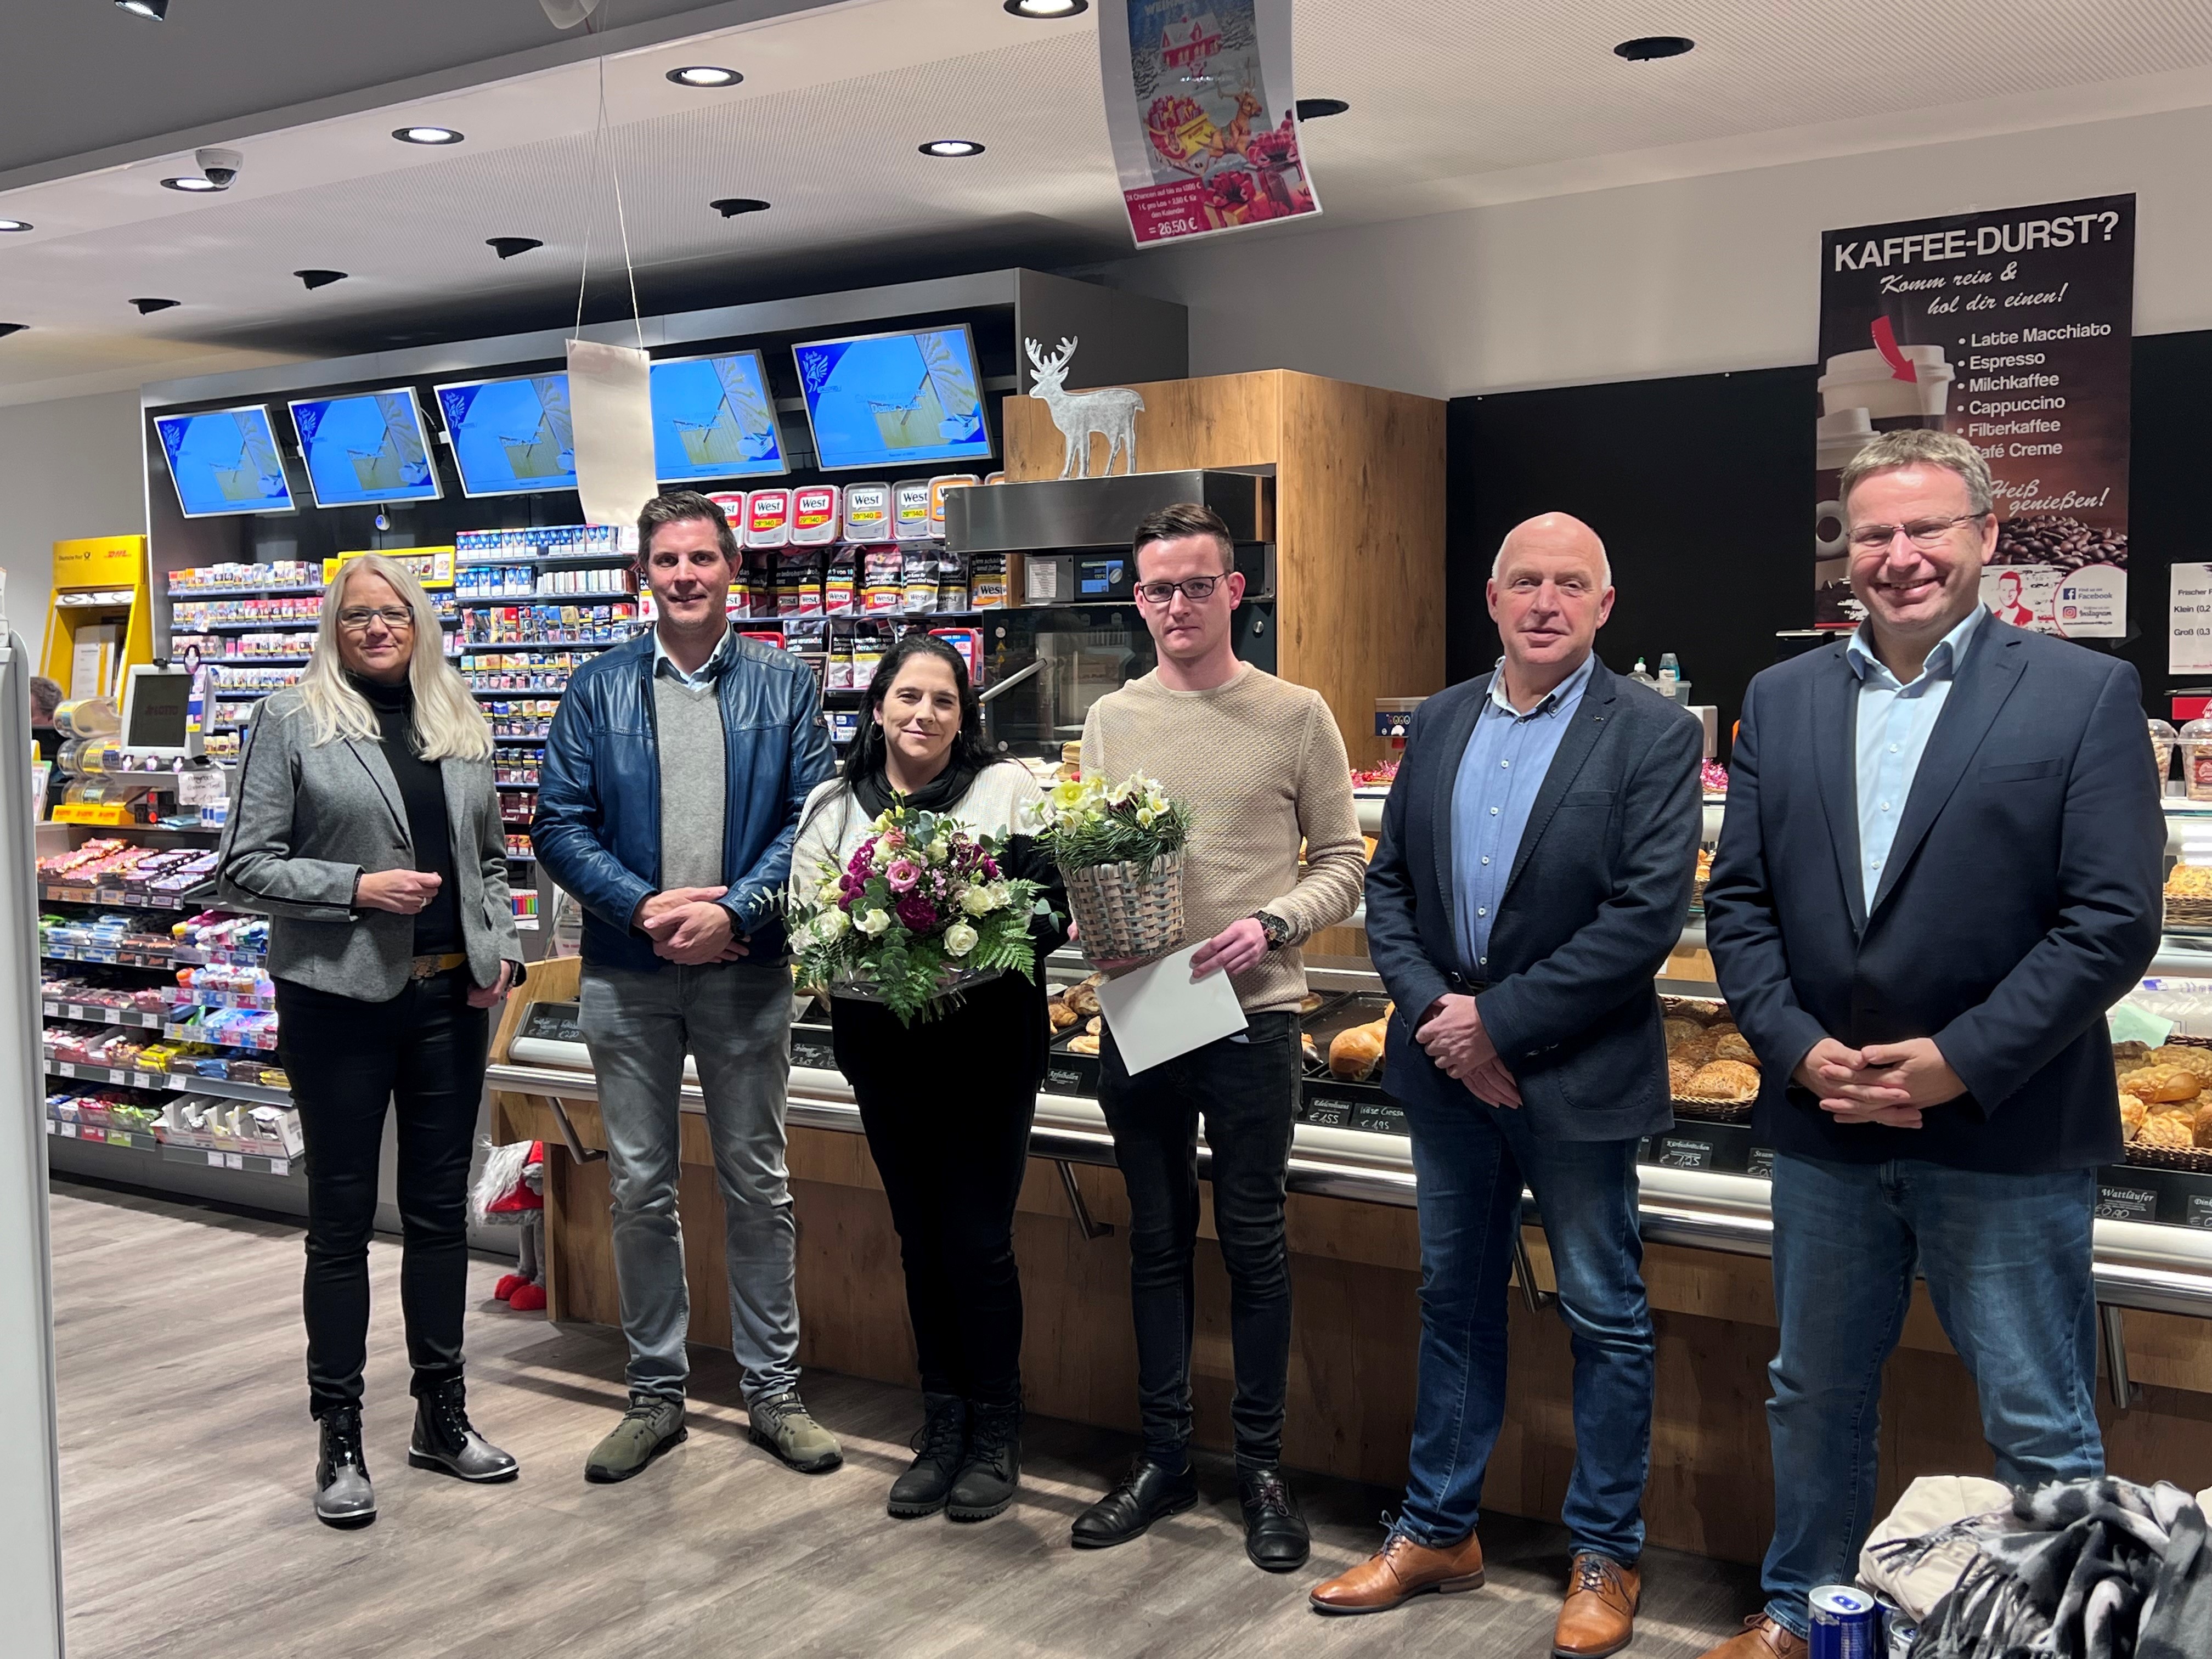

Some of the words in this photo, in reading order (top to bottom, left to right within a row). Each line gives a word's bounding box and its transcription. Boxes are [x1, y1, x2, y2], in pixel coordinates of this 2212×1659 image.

[1158, 219, 1186, 235] 26,50
[1188, 217, 1198, 230] €
[1835, 211, 2119, 272] KAFFEE-DURST?
[1880, 275, 1946, 294] Komm
[1953, 273, 1992, 286] rein
[2001, 261, 2017, 281] &
[1927, 296, 1959, 315] hol
[1966, 294, 1996, 312] dir
[2005, 283, 2069, 308] einen!
[1971, 331, 2018, 347] Latte
[2023, 323, 2111, 343] Macchiato
[1970, 353, 2045, 373] Espresso
[1970, 374, 2059, 392] Milchkaffee
[1969, 397, 2066, 417] Cappuccino
[1969, 420, 2060, 437] Filterkaffee
[2009, 443, 2063, 458] Creme
[904, 493, 927, 502] West
[1991, 479, 2040, 499] Heiß
[758, 502, 781, 511] West
[803, 499, 826, 508] West
[855, 495, 879, 505] West
[2009, 487, 2110, 517] genießen!
[724, 505, 735, 513] est
[108, 550, 127, 558] DHL
[2079, 610, 2112, 618] Instagram
[2102, 1189, 2154, 1203] Wattläufer
